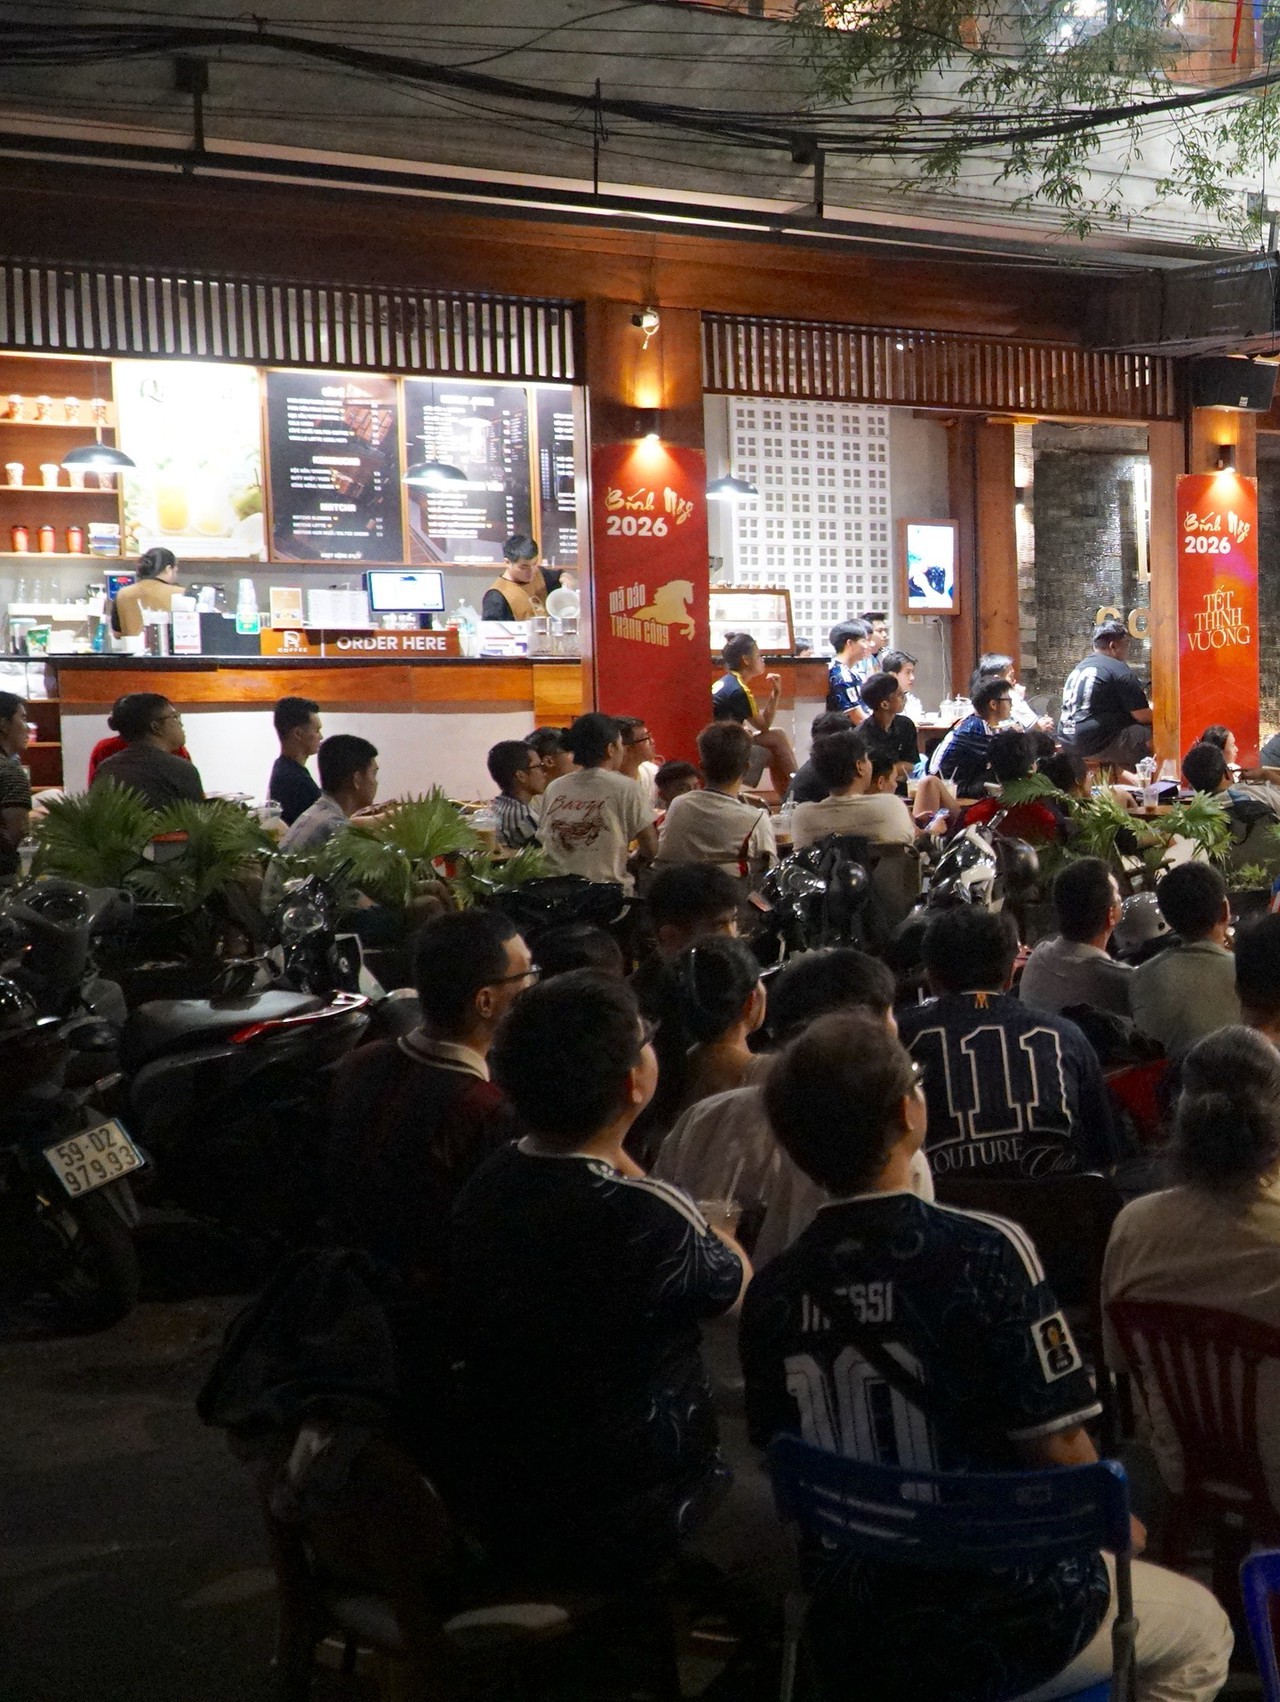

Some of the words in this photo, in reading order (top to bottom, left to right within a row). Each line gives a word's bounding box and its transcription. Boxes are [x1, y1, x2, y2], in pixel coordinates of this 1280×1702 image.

[606, 515, 669, 538] 2026
[1185, 535, 1231, 555] 2026
[1203, 585, 1234, 613] TẾT
[277, 646, 308, 654] COFFEE
[336, 635, 399, 651] ORDER
[402, 636, 448, 651] HERE
[65, 1145, 137, 1193] 979.93
[801, 1281, 894, 1333] MSSI
[784, 1341, 942, 1504] 10
